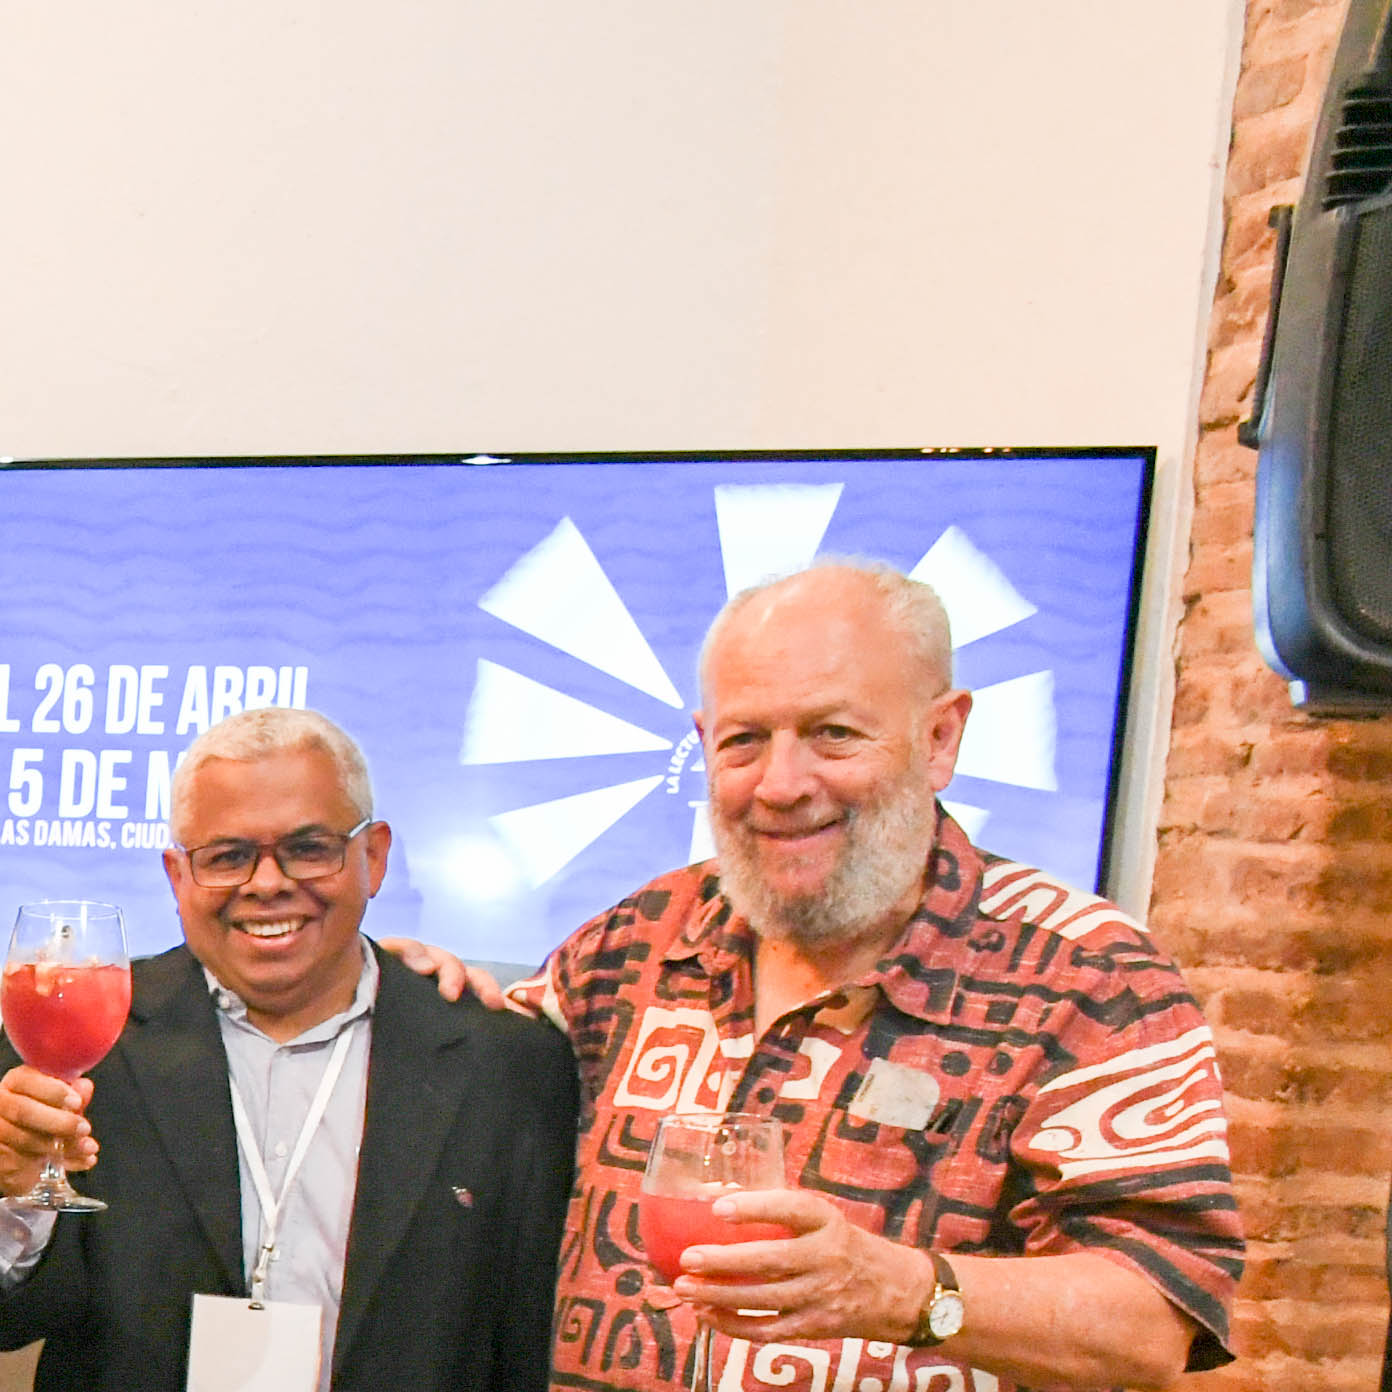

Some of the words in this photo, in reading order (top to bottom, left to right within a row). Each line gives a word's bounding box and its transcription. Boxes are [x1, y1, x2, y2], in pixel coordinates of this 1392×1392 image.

[31, 663, 96, 734] 26
[104, 664, 169, 735] DE
[8, 747, 44, 818] 5
[58, 748, 133, 820] DE
[34, 820, 116, 849] DAMAS,
[121, 821, 175, 849] CIUD
